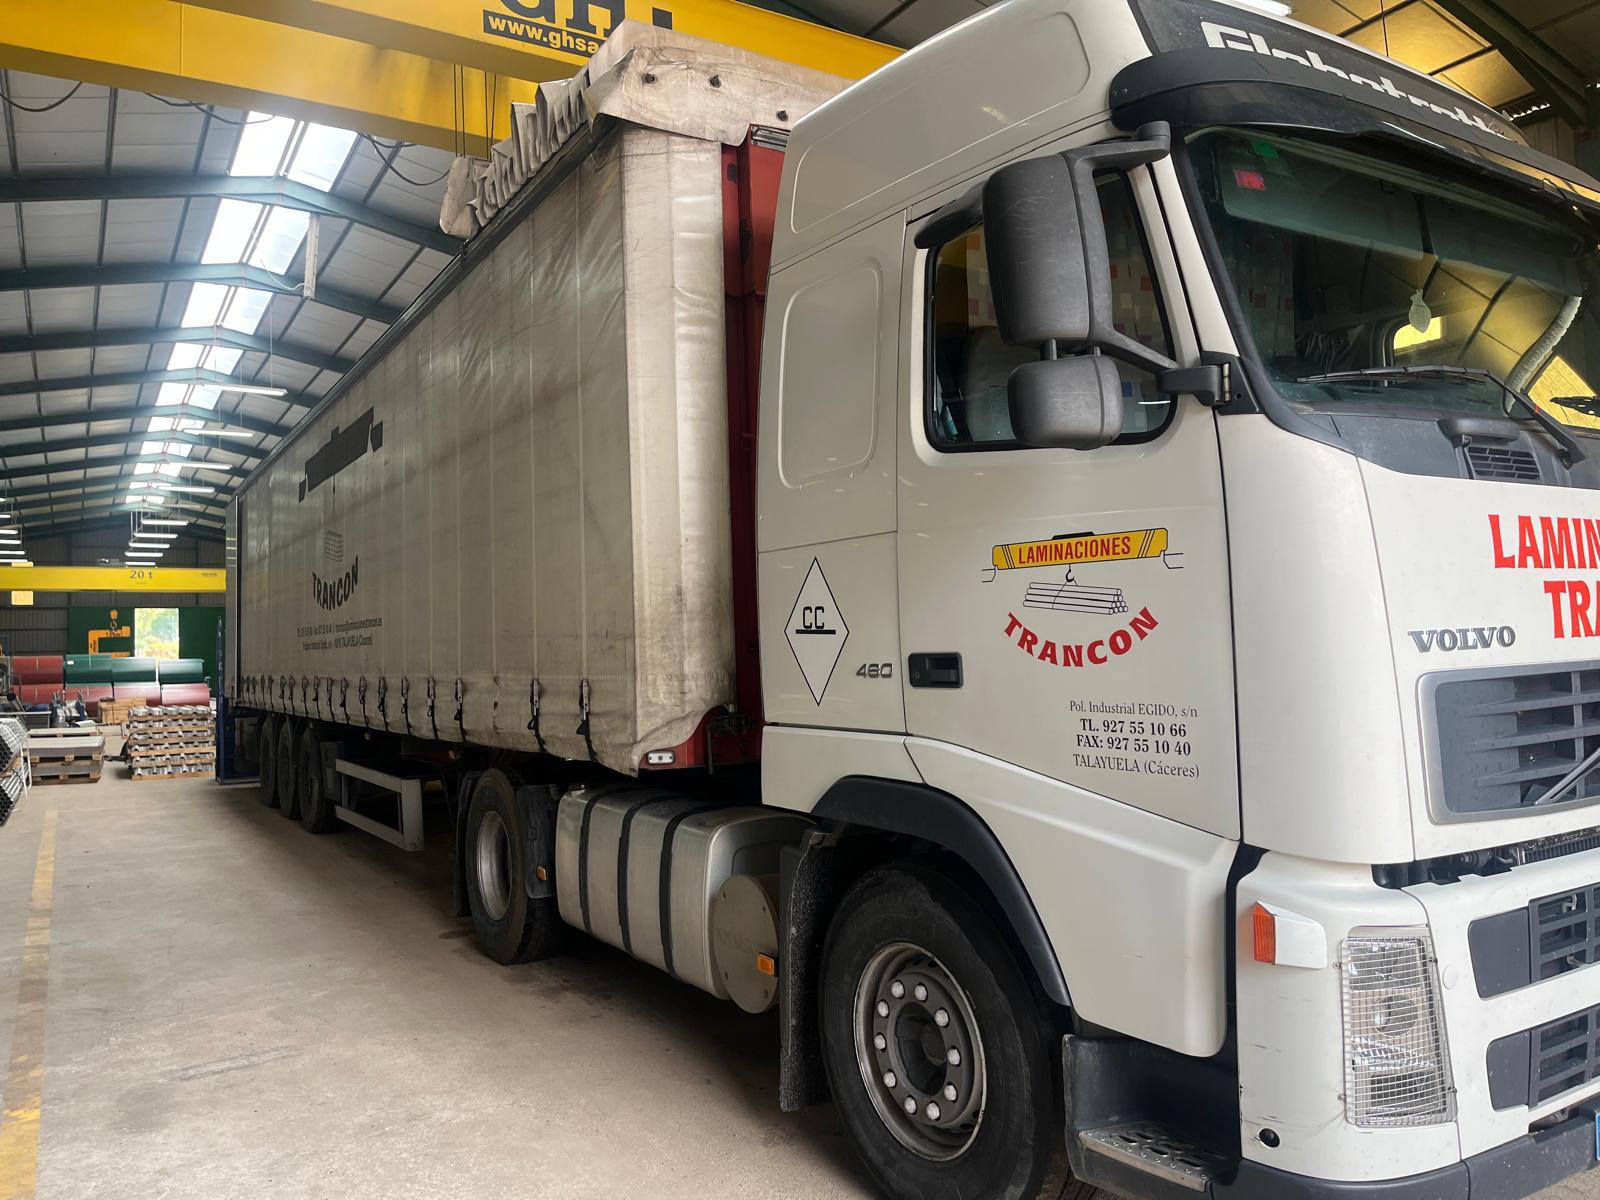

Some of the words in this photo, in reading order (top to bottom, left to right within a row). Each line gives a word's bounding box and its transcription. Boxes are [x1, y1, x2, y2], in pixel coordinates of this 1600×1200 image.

[1018, 535, 1132, 565] LAMINACIONES
[130, 570, 144, 579] 20
[148, 571, 153, 579] t
[312, 553, 358, 611] TRANCON
[802, 606, 825, 630] CC
[1543, 580, 1600, 639] TR
[1004, 606, 1159, 668] TRANCON
[1407, 625, 1516, 653] VOLVO
[856, 663, 893, 679] 460
[1070, 700, 1087, 712] Pol.
[1089, 701, 1136, 715] Industrial
[1138, 703, 1178, 717] EGIDO,
[1181, 705, 1198, 718] s/n
[1080, 718, 1099, 732] TL.
[1103, 719, 1125, 733] 927
[1129, 721, 1145, 735] 55
[1150, 722, 1165, 736] 10
[1170, 723, 1187, 737] 66
[1076, 734, 1104, 749] FAX:
[1107, 736, 1129, 751] 927
[1134, 738, 1149, 752] 55
[1155, 740, 1170, 754] 10
[1174, 741, 1191, 756] 40
[1073, 753, 1140, 773] TALAYUELA
[1144, 760, 1200, 779] (Cáceres)
